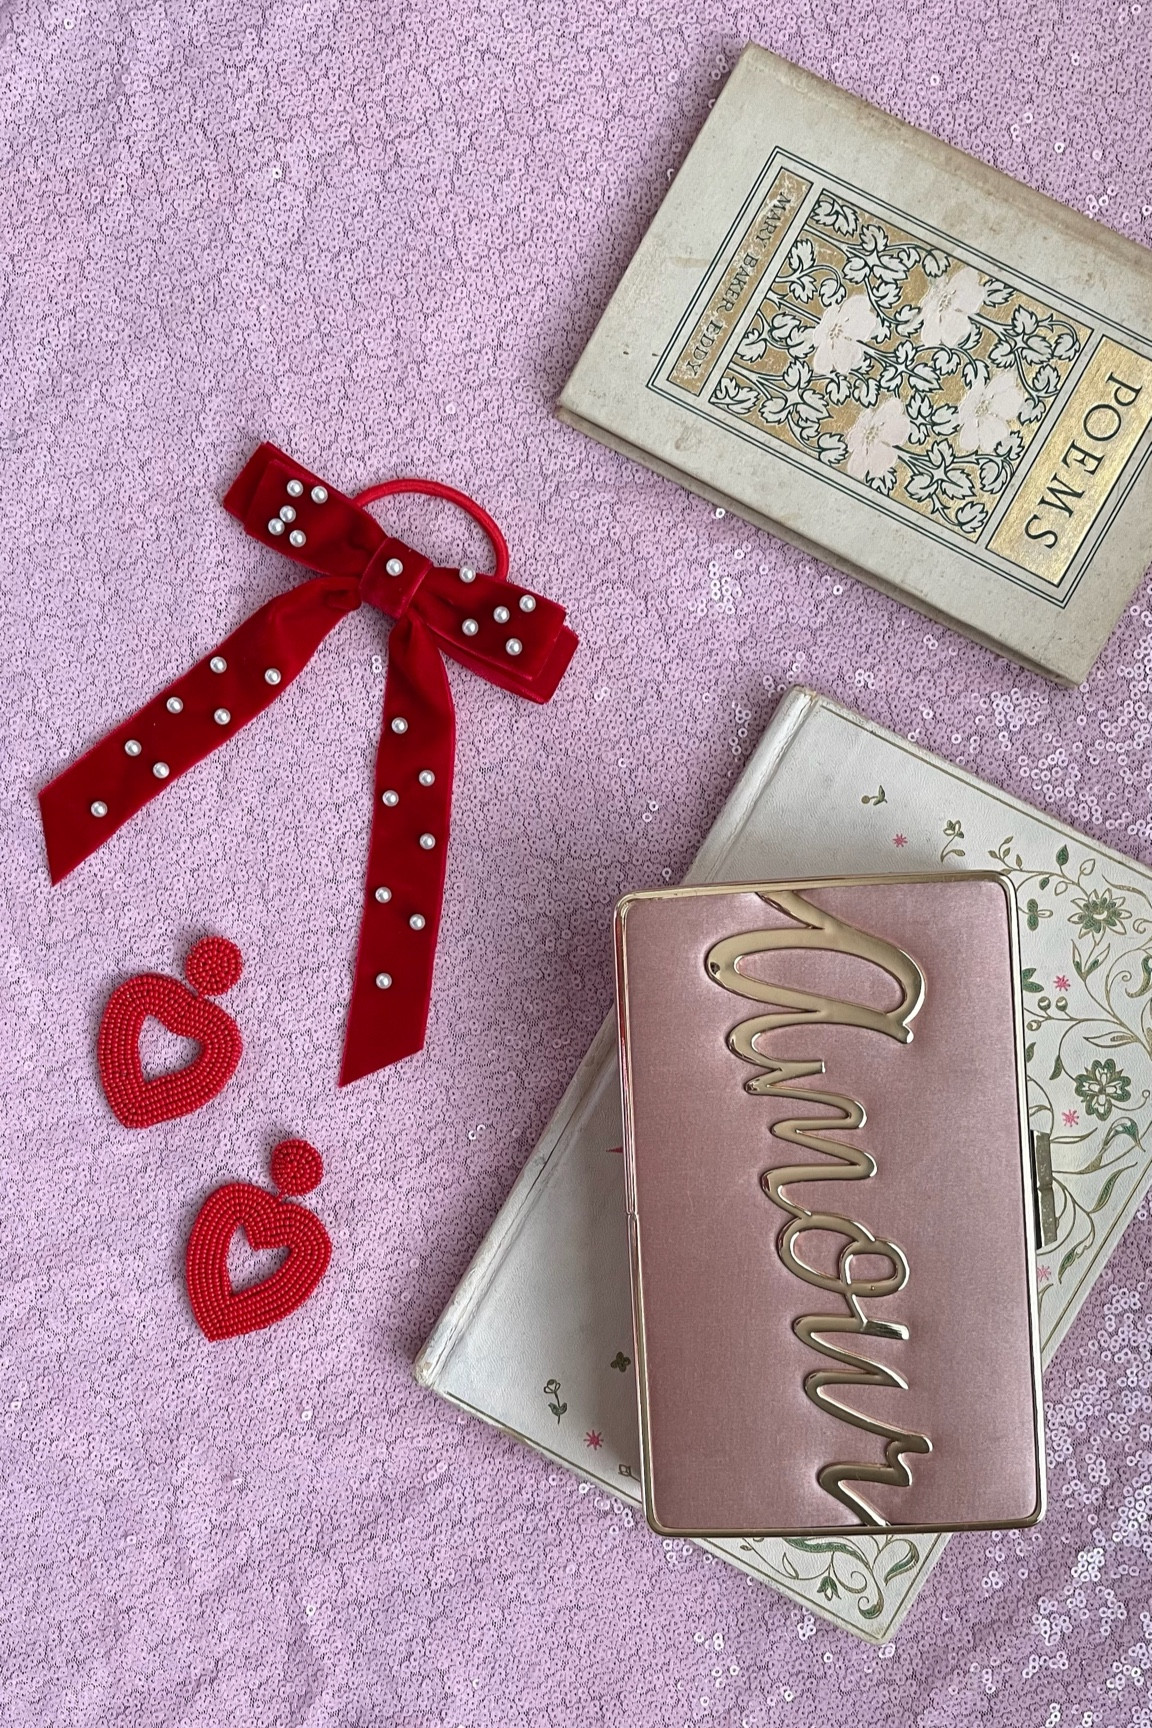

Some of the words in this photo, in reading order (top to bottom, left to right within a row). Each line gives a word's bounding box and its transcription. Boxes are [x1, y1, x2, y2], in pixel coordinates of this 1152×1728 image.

[756, 191, 792, 248] MARY
[716, 253, 760, 313] BAKER
[686, 319, 723, 377] EDDY
[1024, 371, 1143, 549] POEMS
